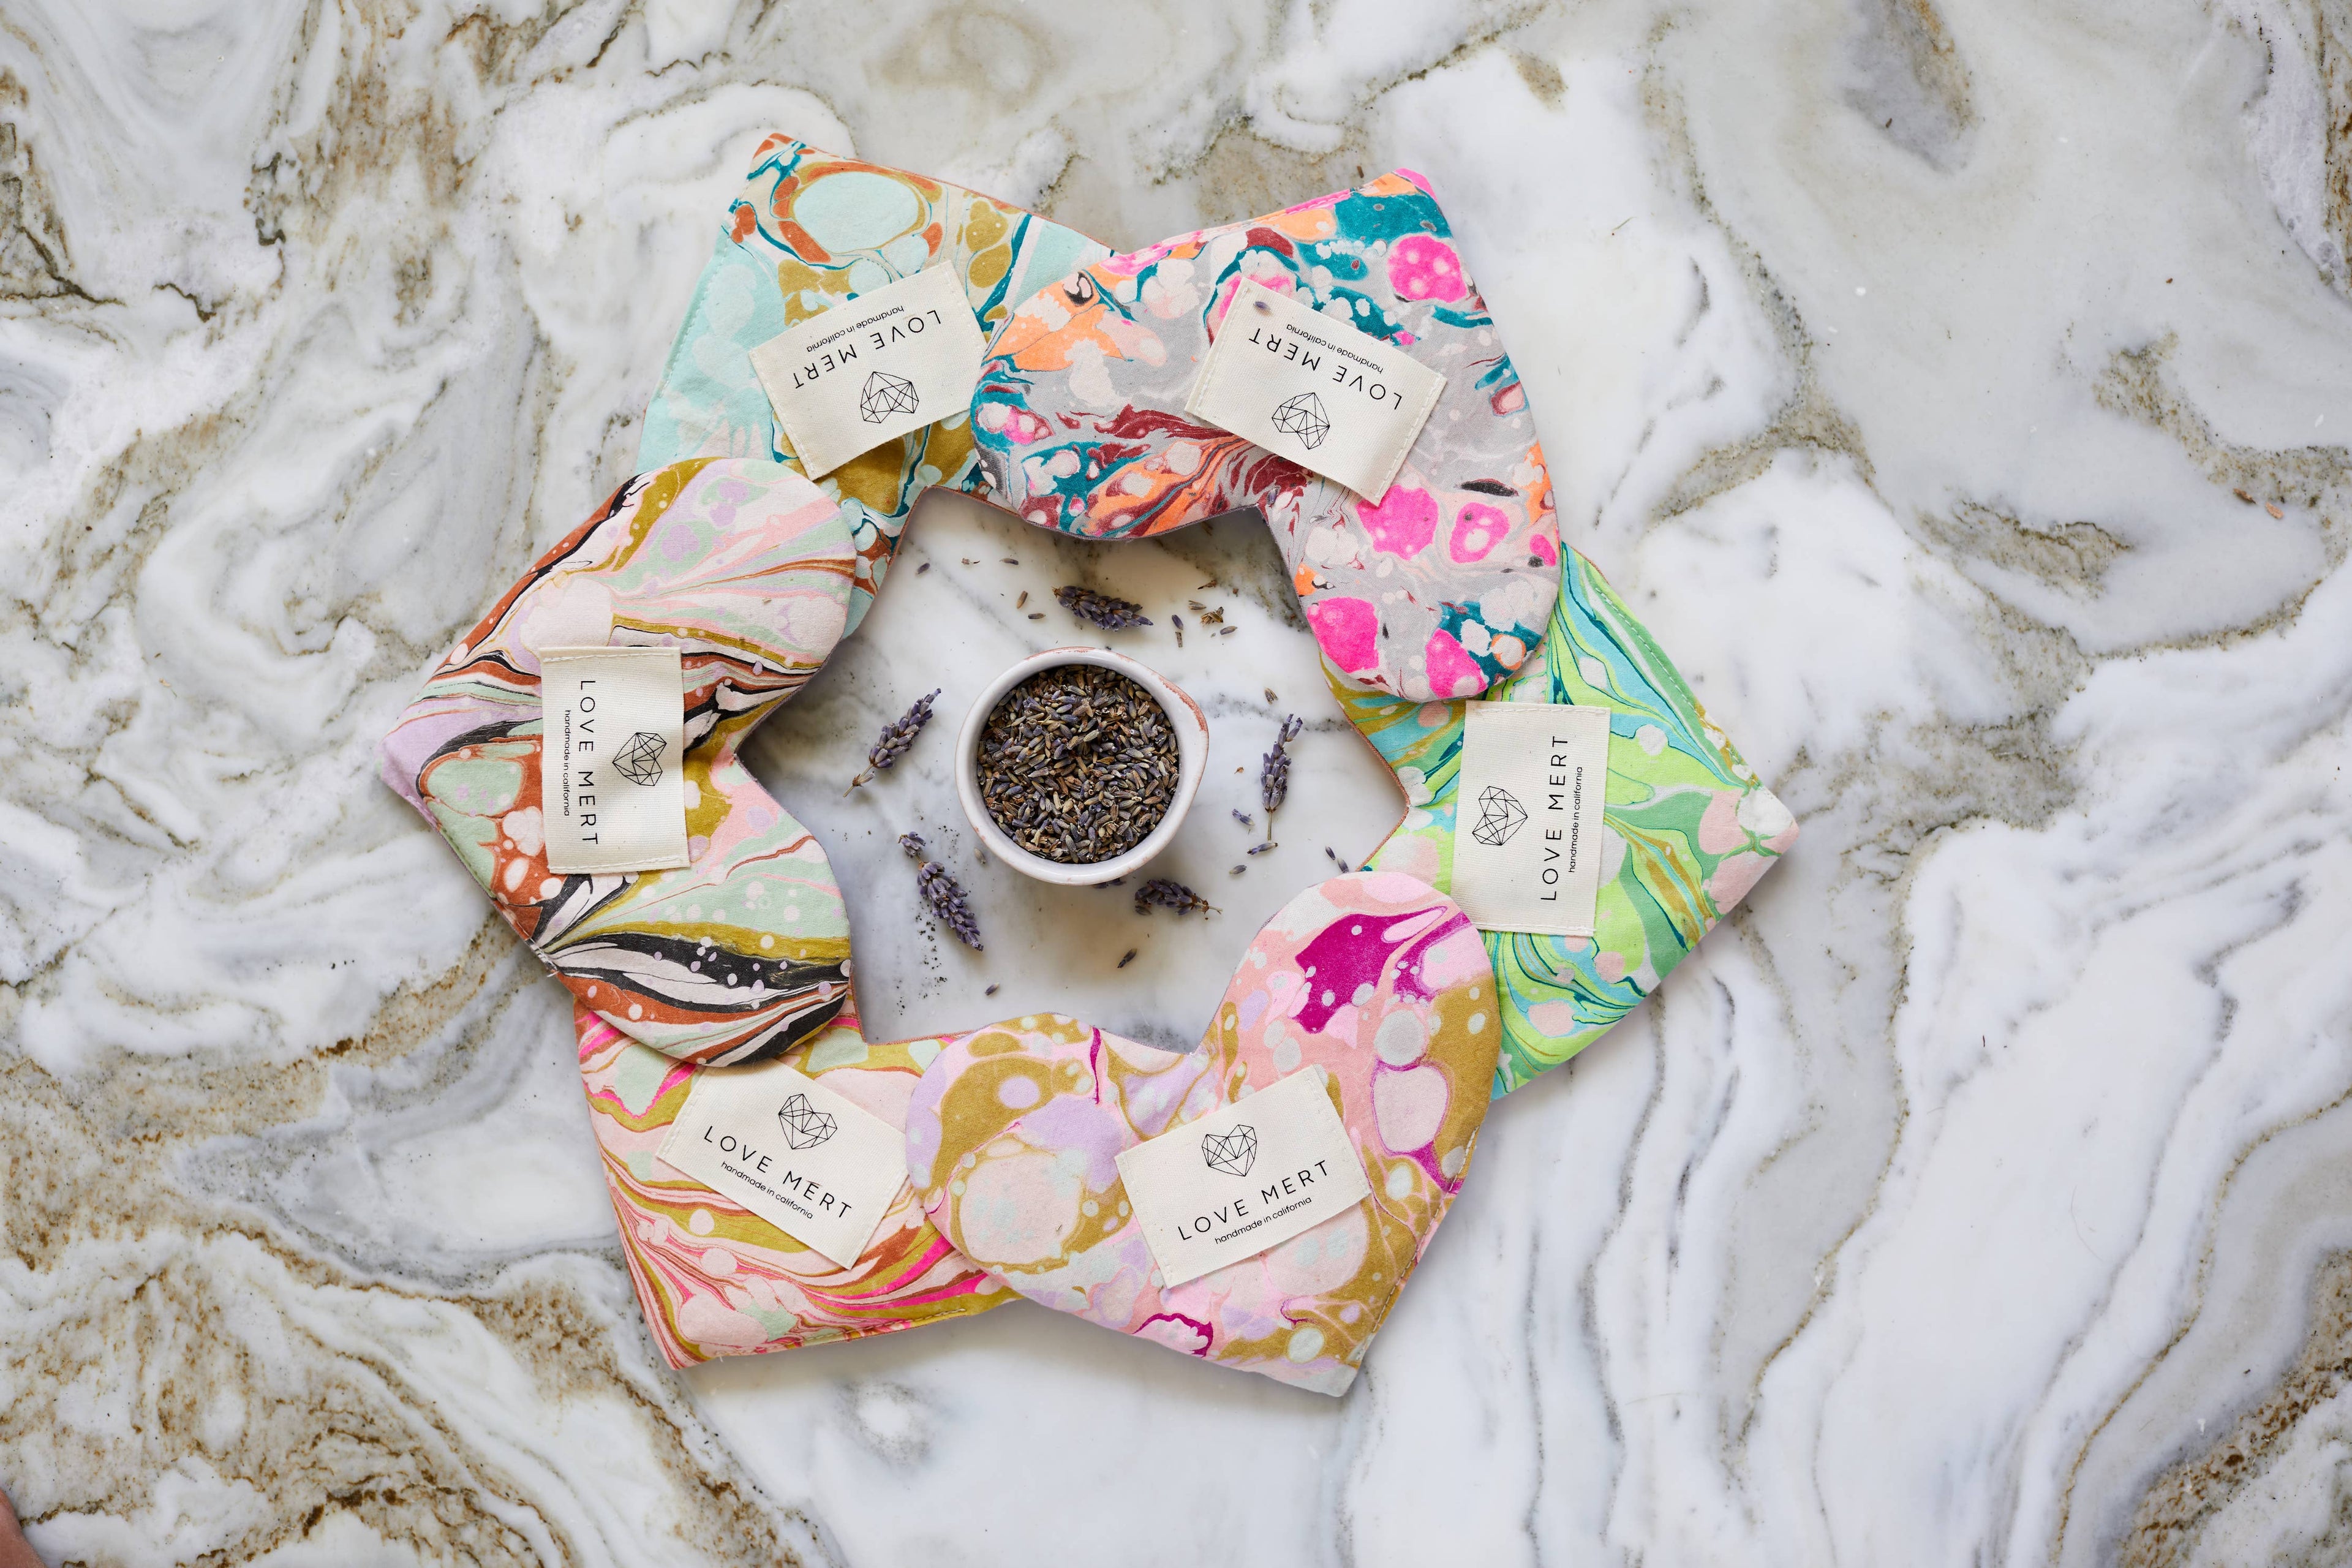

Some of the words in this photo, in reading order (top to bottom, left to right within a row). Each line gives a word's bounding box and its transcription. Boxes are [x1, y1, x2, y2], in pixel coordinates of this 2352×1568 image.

[846, 324, 856, 333] in
[856, 305, 904, 329] handmade
[870, 310, 941, 350] LOVE
[1286, 324, 1327, 347] california
[807, 330, 845, 352] california
[1248, 328, 1321, 371] MERT
[1337, 347, 1383, 374] handmade
[793, 344, 857, 389] MERT
[1333, 365, 1402, 410] LOVE
[579, 680, 596, 752] LOVE
[1548, 736, 1567, 810] MERT
[1574, 767, 1583, 811] california
[578, 771, 598, 844] MERT
[1573, 813, 1580, 821] in
[1541, 829, 1562, 900] LOVE
[1568, 823, 1578, 873] handmade
[704, 1126, 772, 1173] LOVE
[783, 1170, 851, 1218] MERT
[722, 1161, 766, 1191] handmade
[766, 1188, 775, 1197] in
[775, 1193, 813, 1219] california
[1178, 1199, 1249, 1240] LOVE
[1261, 1160, 1329, 1204] MERT
[1215, 1219, 1262, 1245] handmade
[1263, 1215, 1272, 1224] in
[1272, 1197, 1312, 1220] california
